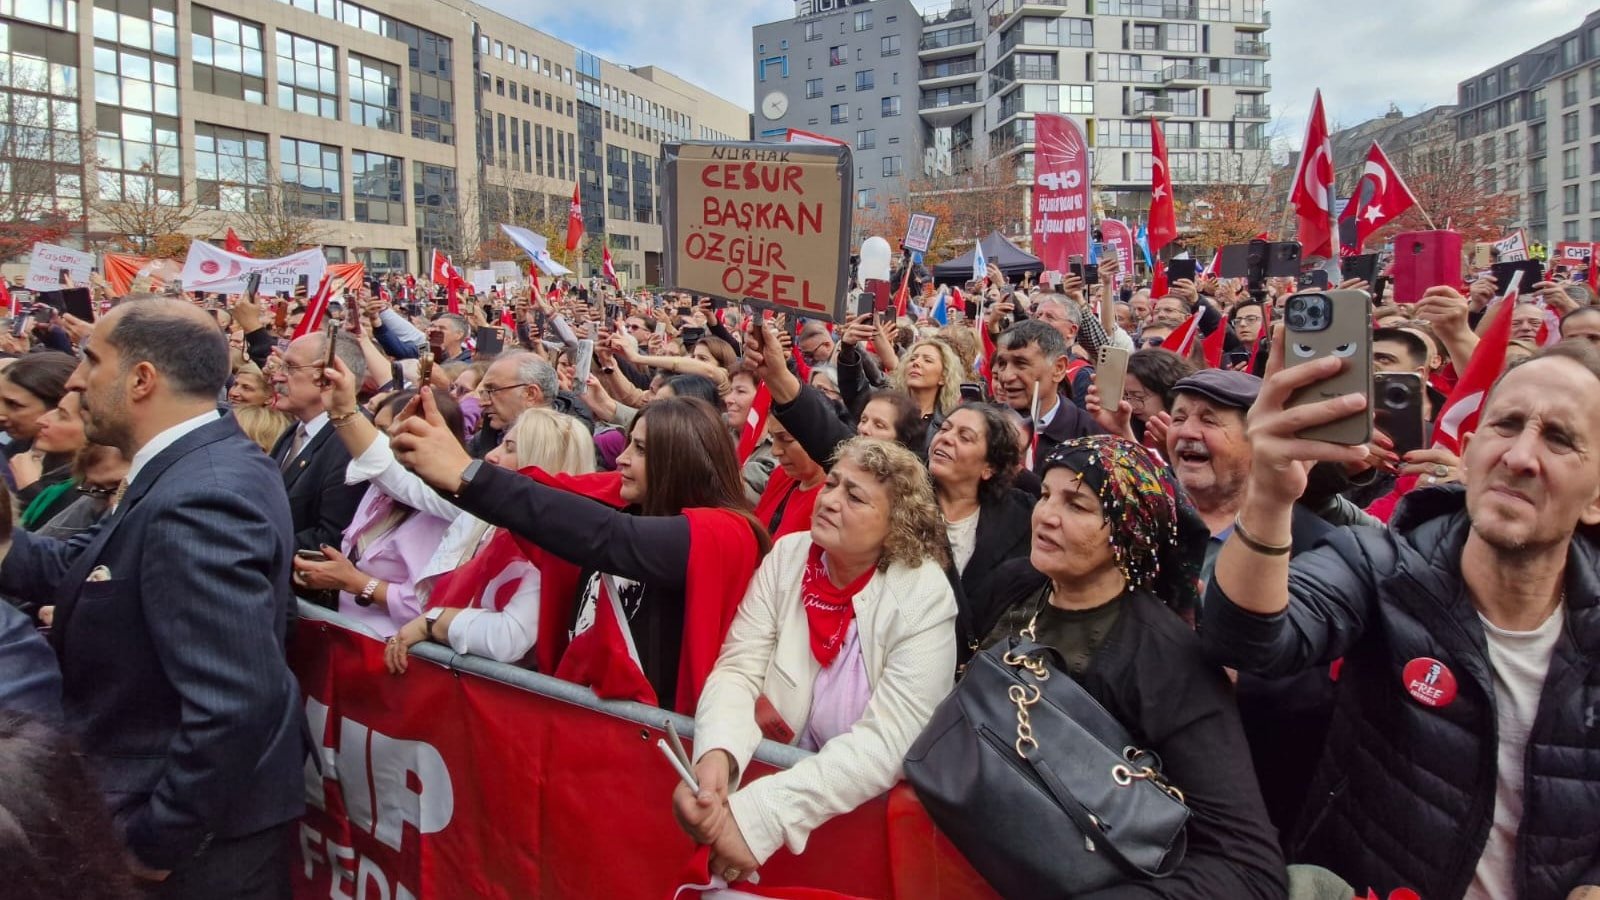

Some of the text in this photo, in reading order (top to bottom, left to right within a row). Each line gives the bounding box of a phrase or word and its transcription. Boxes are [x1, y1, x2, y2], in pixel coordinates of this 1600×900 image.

[711, 147, 790, 162] NURHAK
[702, 162, 804, 195] CESUR
[703, 196, 823, 235] BAŞKAN
[685, 224, 786, 270] ÖZGÜR
[1567, 248, 1591, 258] CHP
[722, 262, 826, 311] ÖZEL
[1410, 680, 1444, 699] FREE
[304, 694, 454, 853] HP
